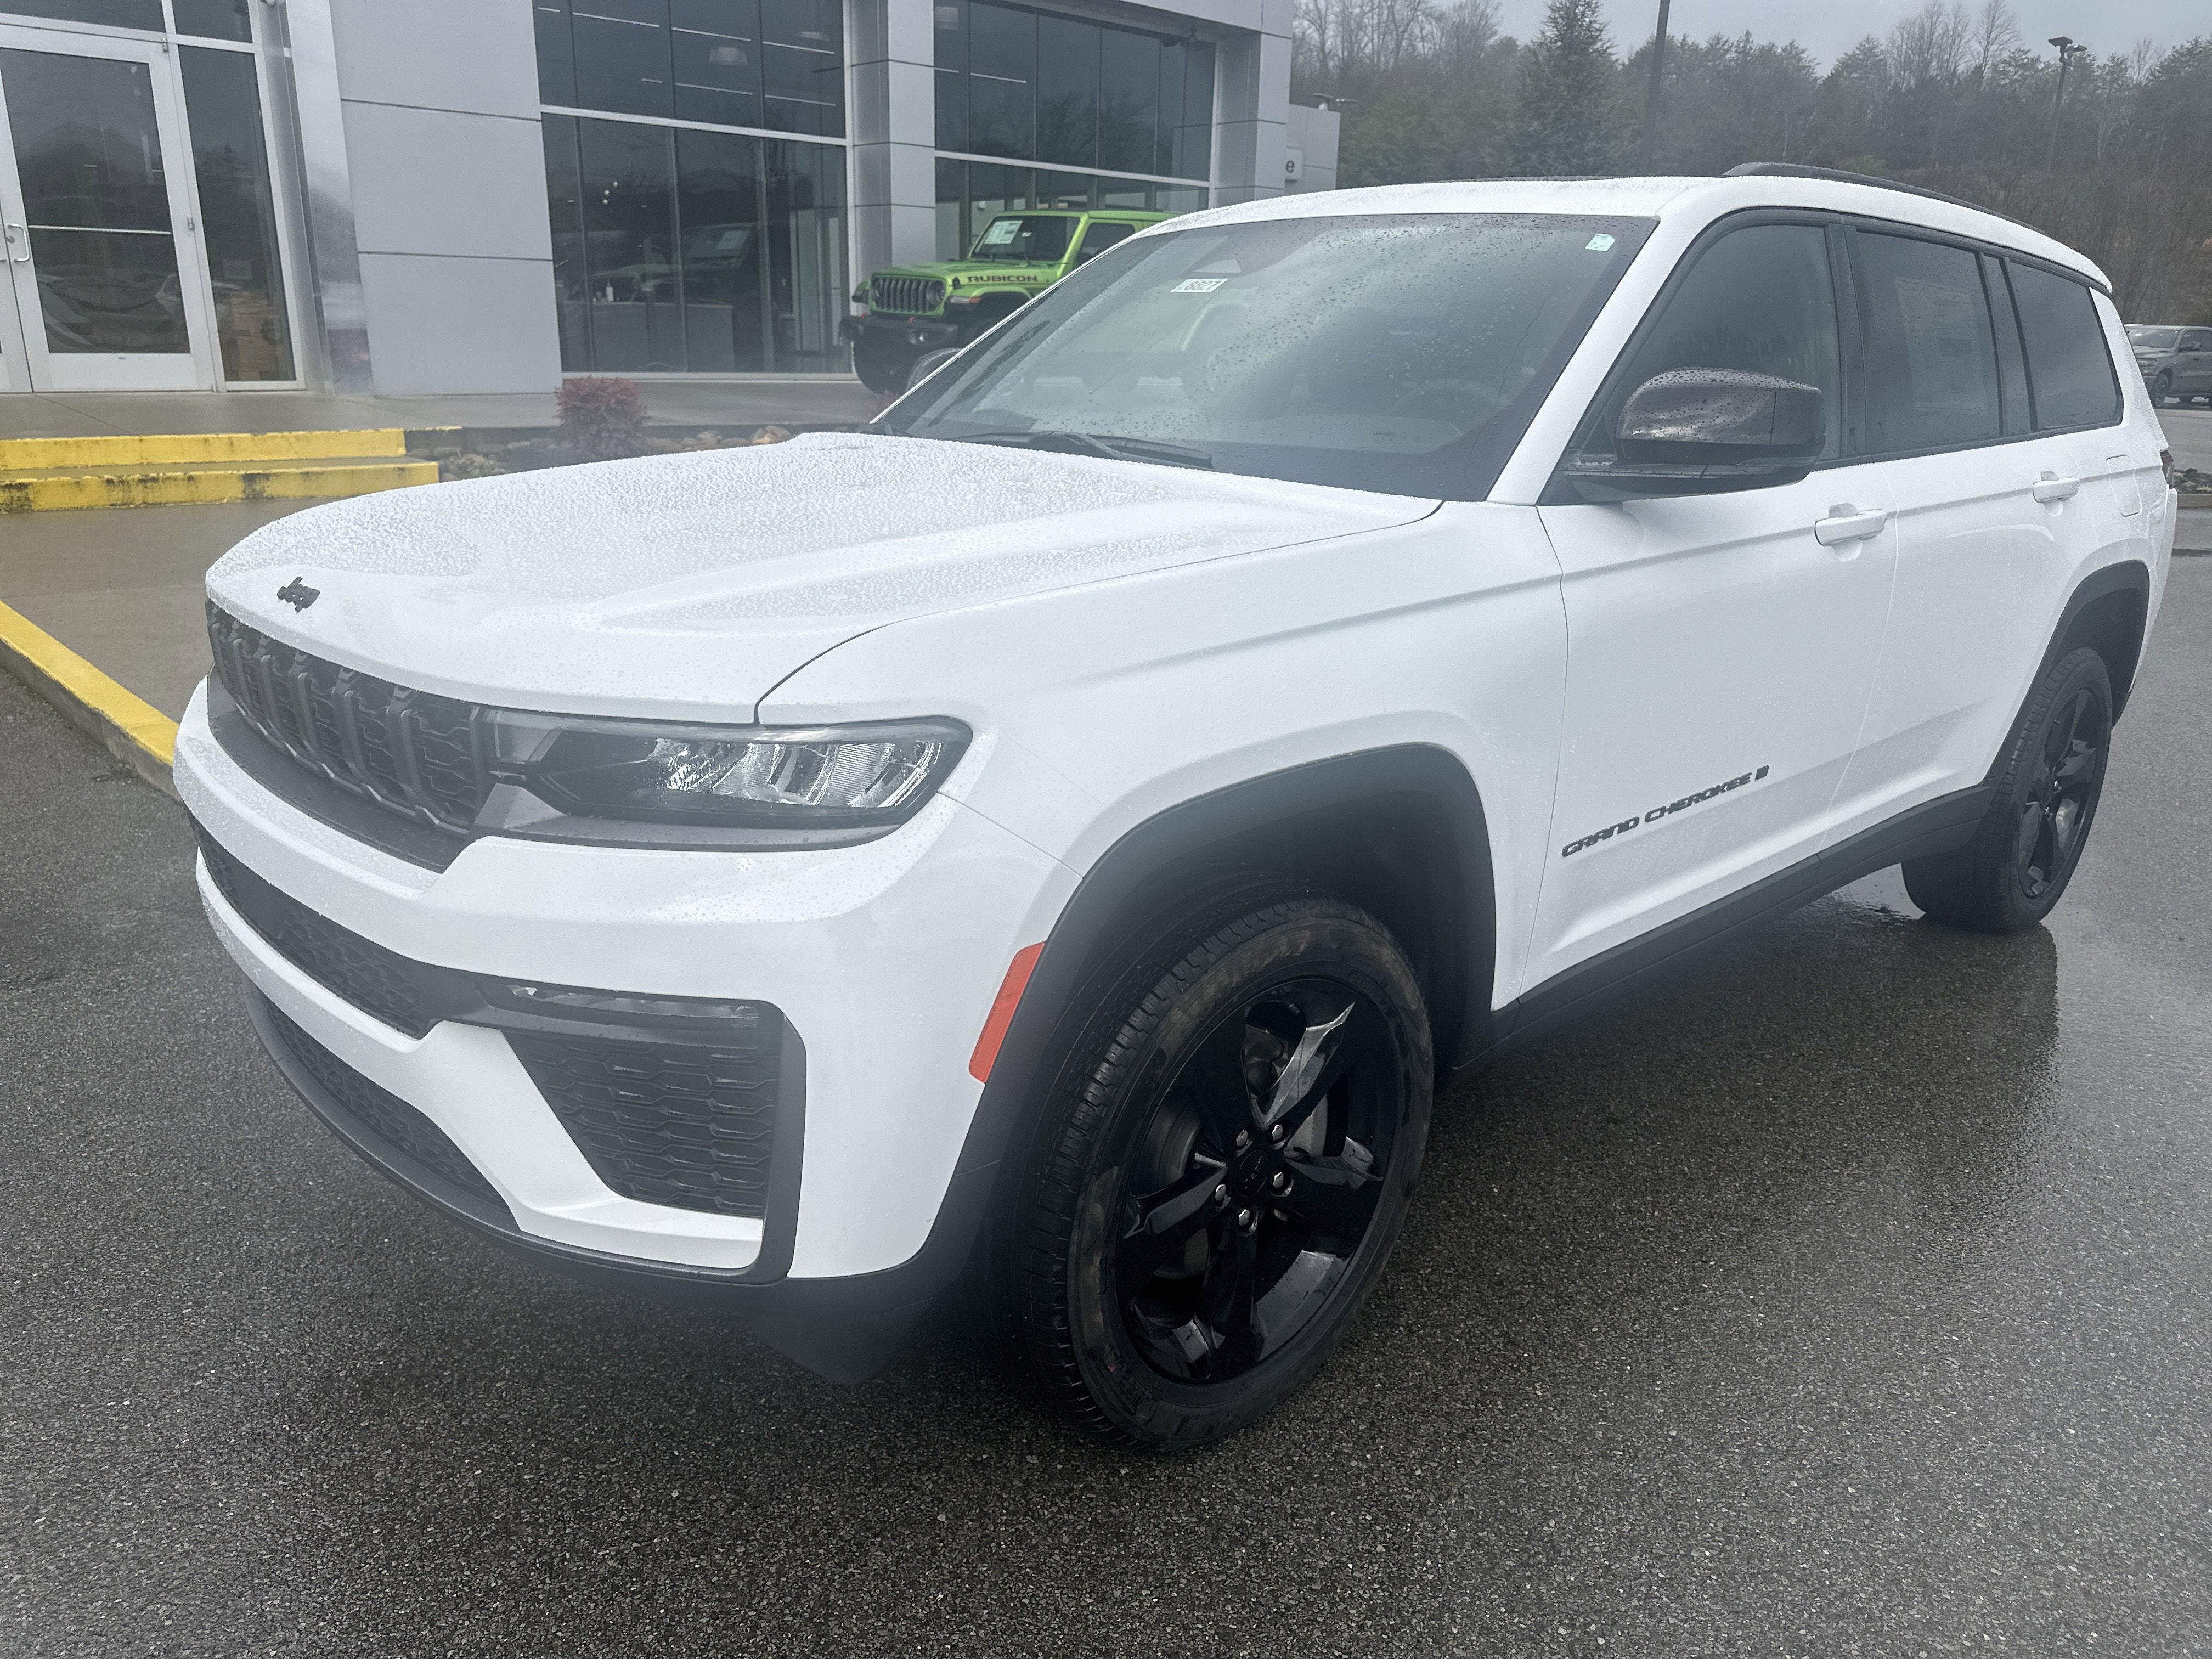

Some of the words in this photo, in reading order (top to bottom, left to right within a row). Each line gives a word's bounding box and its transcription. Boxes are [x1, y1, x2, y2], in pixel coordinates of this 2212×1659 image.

[1184, 280, 1222, 290] 8827
[1562, 816, 1640, 857] GRAND
[1645, 772, 1752, 823] CHEROKEE
